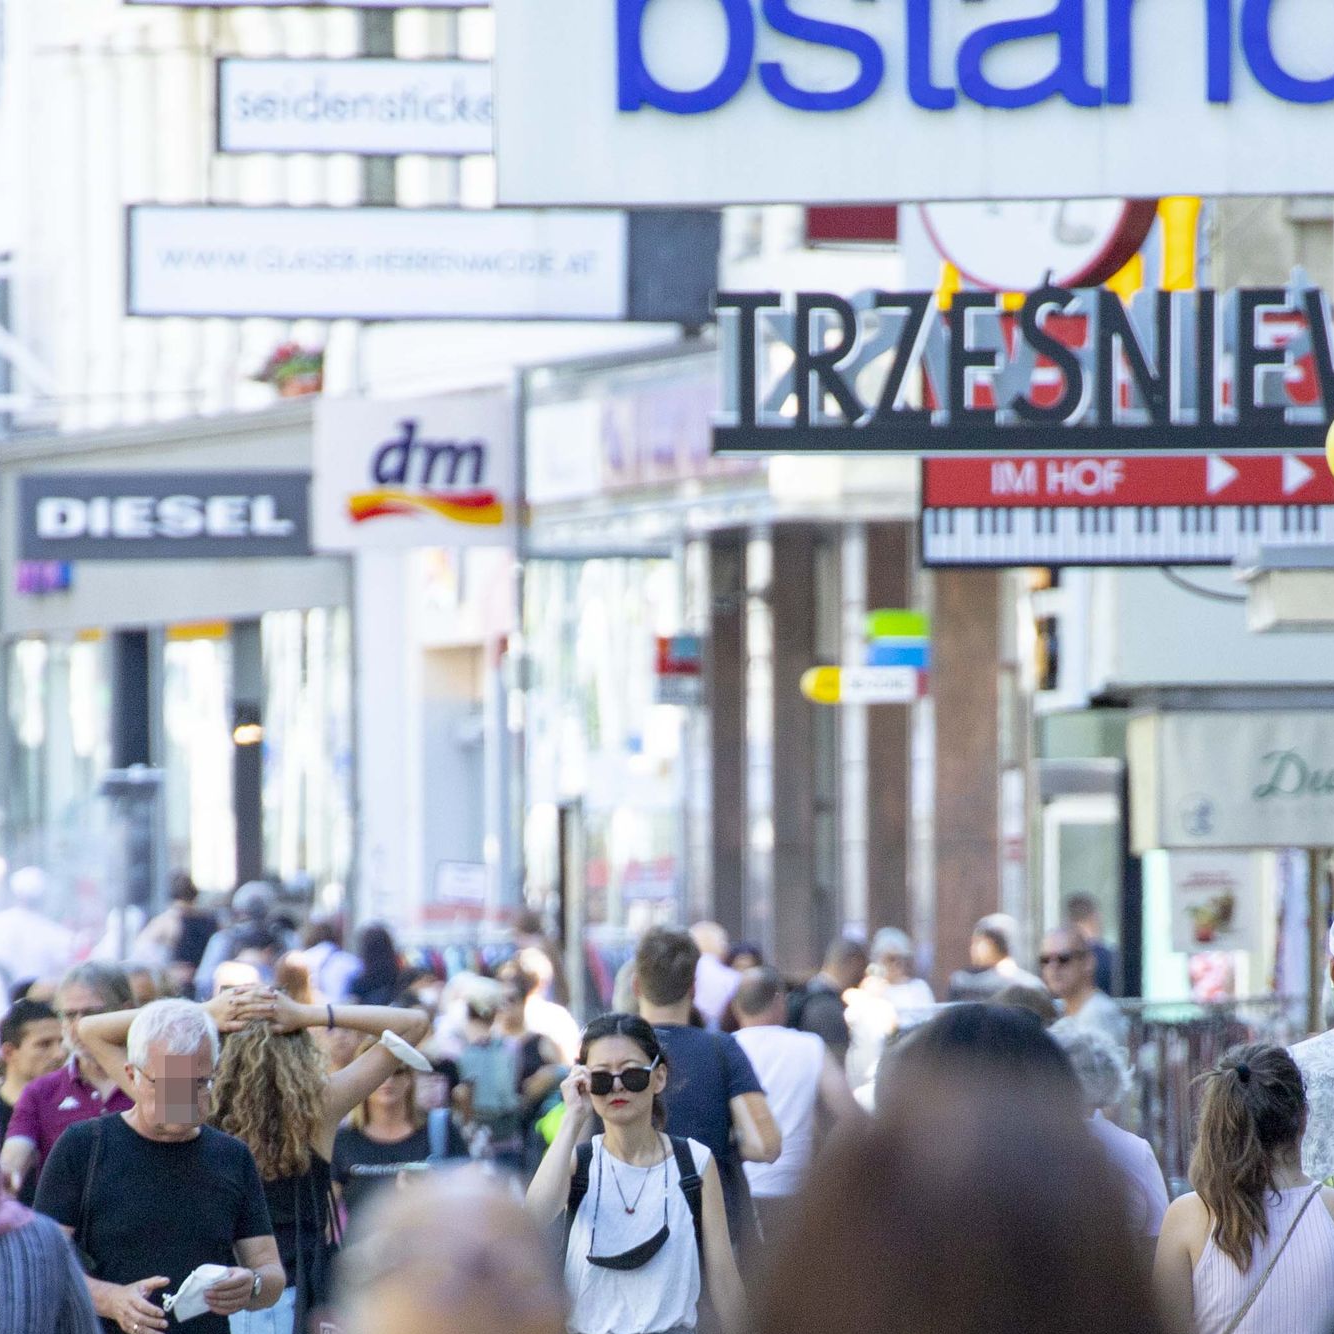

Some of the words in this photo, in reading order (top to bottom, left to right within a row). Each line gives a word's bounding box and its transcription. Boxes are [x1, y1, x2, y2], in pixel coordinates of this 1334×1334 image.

[372, 419, 485, 486] dm
[1046, 459, 1124, 495] HOF
[36, 494, 295, 539] DIESEL
